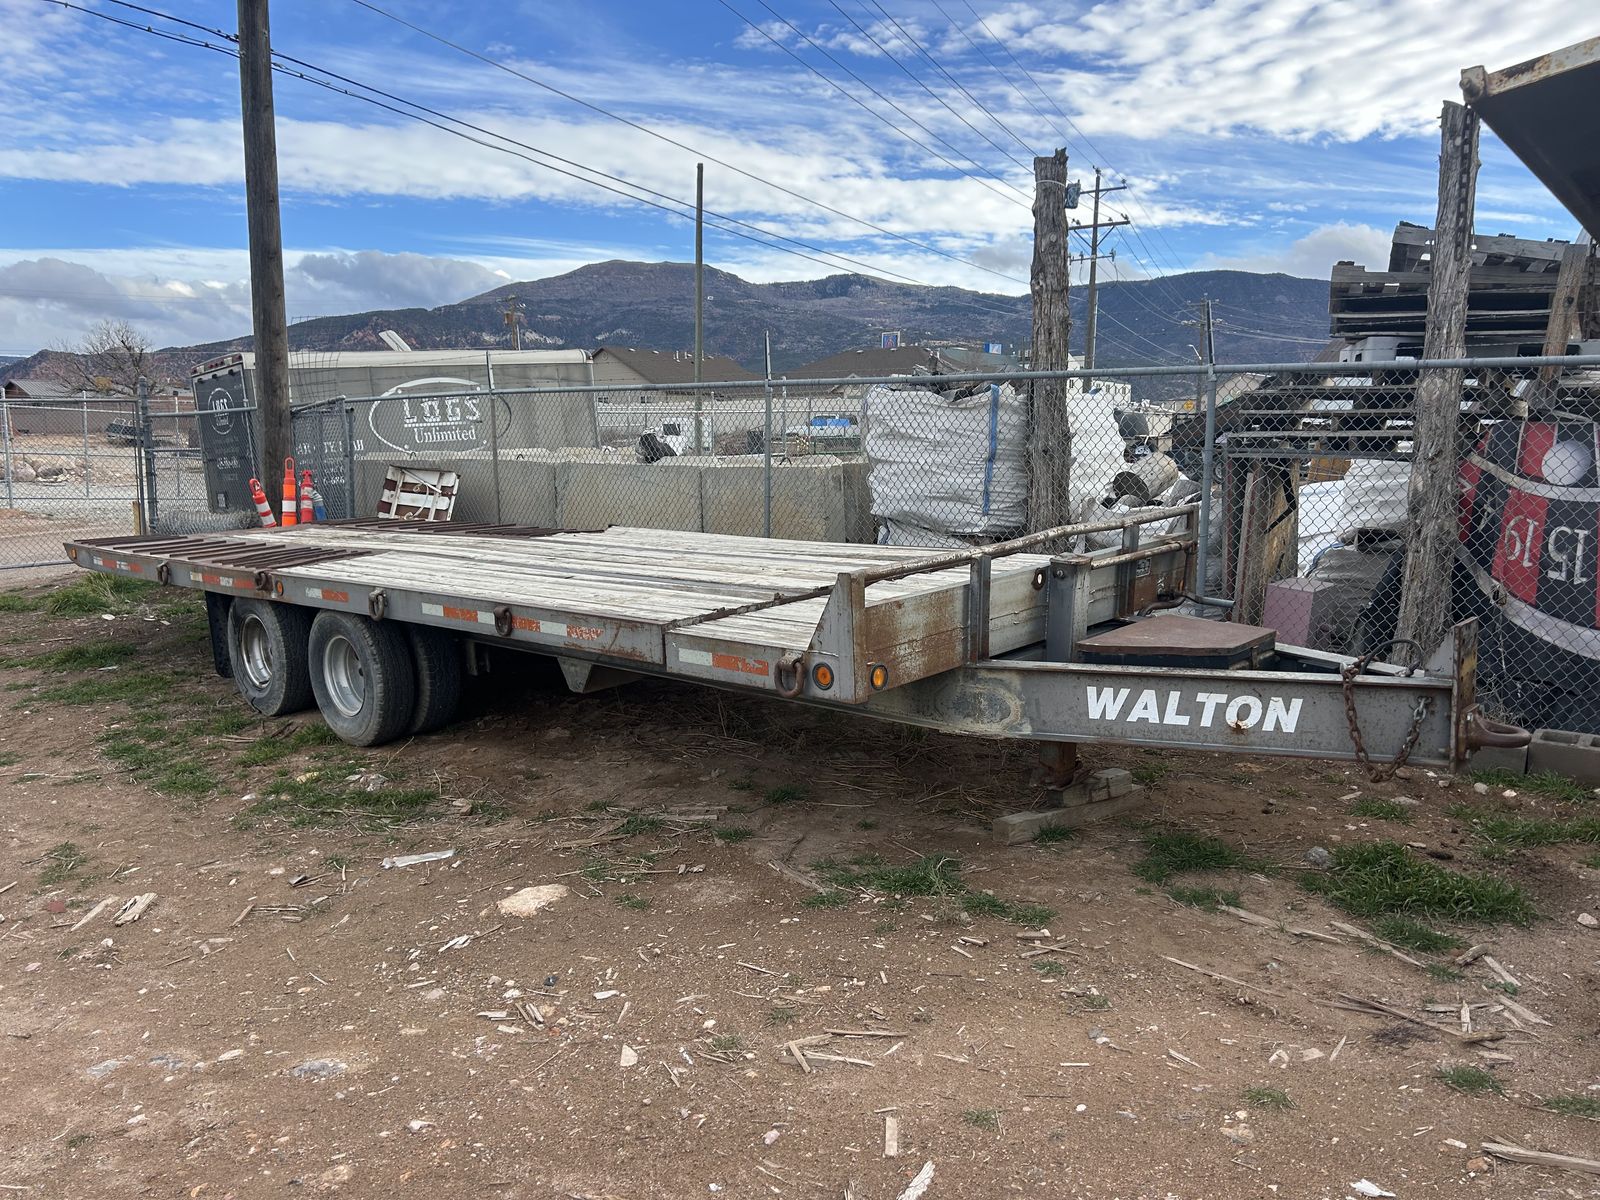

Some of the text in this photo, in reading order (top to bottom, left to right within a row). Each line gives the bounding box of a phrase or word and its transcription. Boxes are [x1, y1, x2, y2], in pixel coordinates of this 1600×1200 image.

[403, 396, 481, 423] LOGS
[414, 426, 477, 444] Unlimited
[1504, 514, 1539, 568] 19
[1547, 526, 1591, 585] 15
[1086, 685, 1304, 733] WALTON
